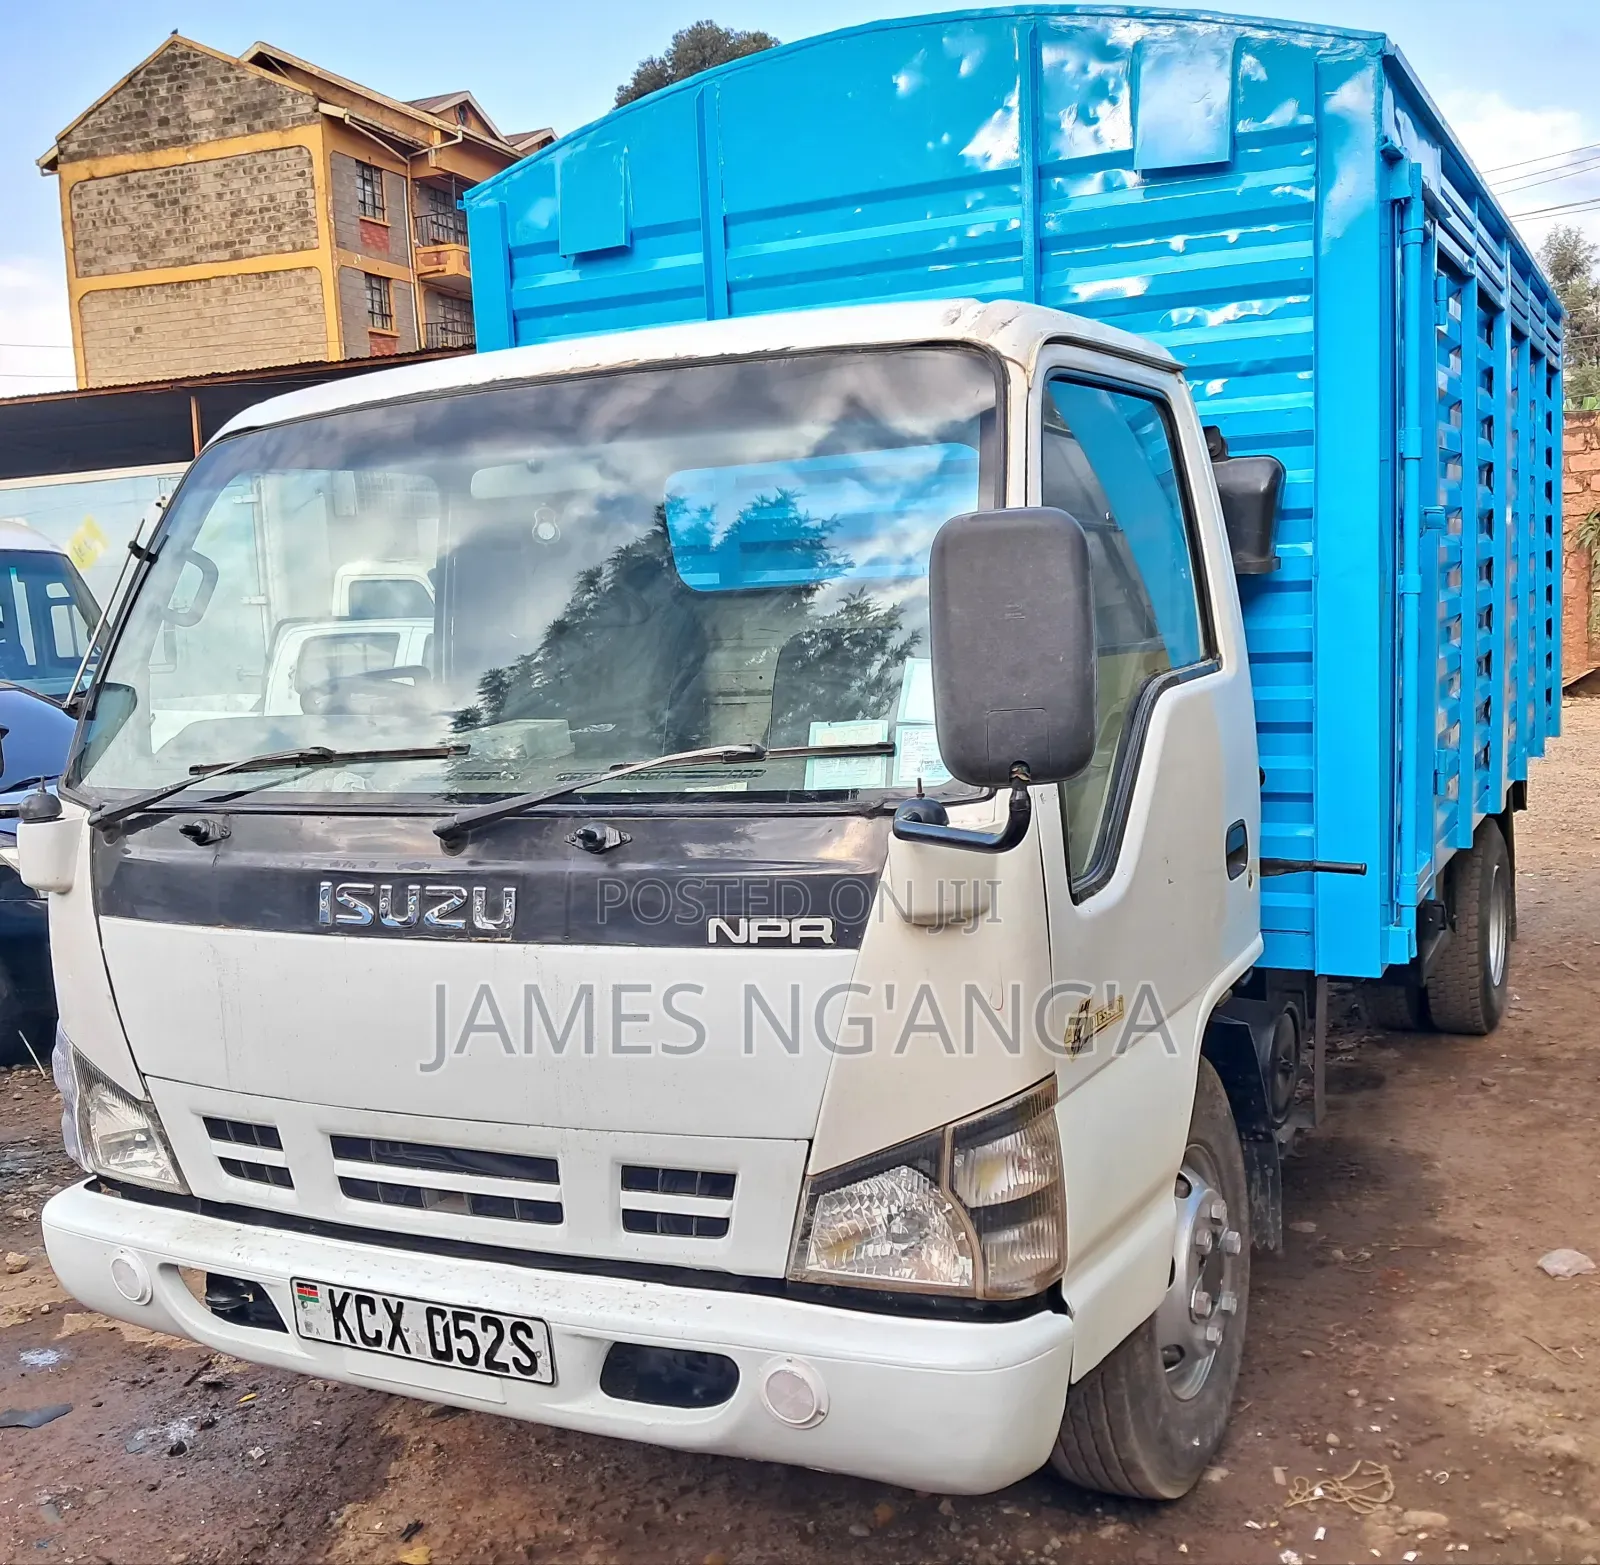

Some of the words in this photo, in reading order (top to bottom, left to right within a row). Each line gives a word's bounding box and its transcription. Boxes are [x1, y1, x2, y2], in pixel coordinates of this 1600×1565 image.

[318, 880, 518, 931] ISUZU
[707, 916, 835, 945] NPR
[328, 1288, 412, 1354] KCX
[425, 1306, 539, 1376] 052S
